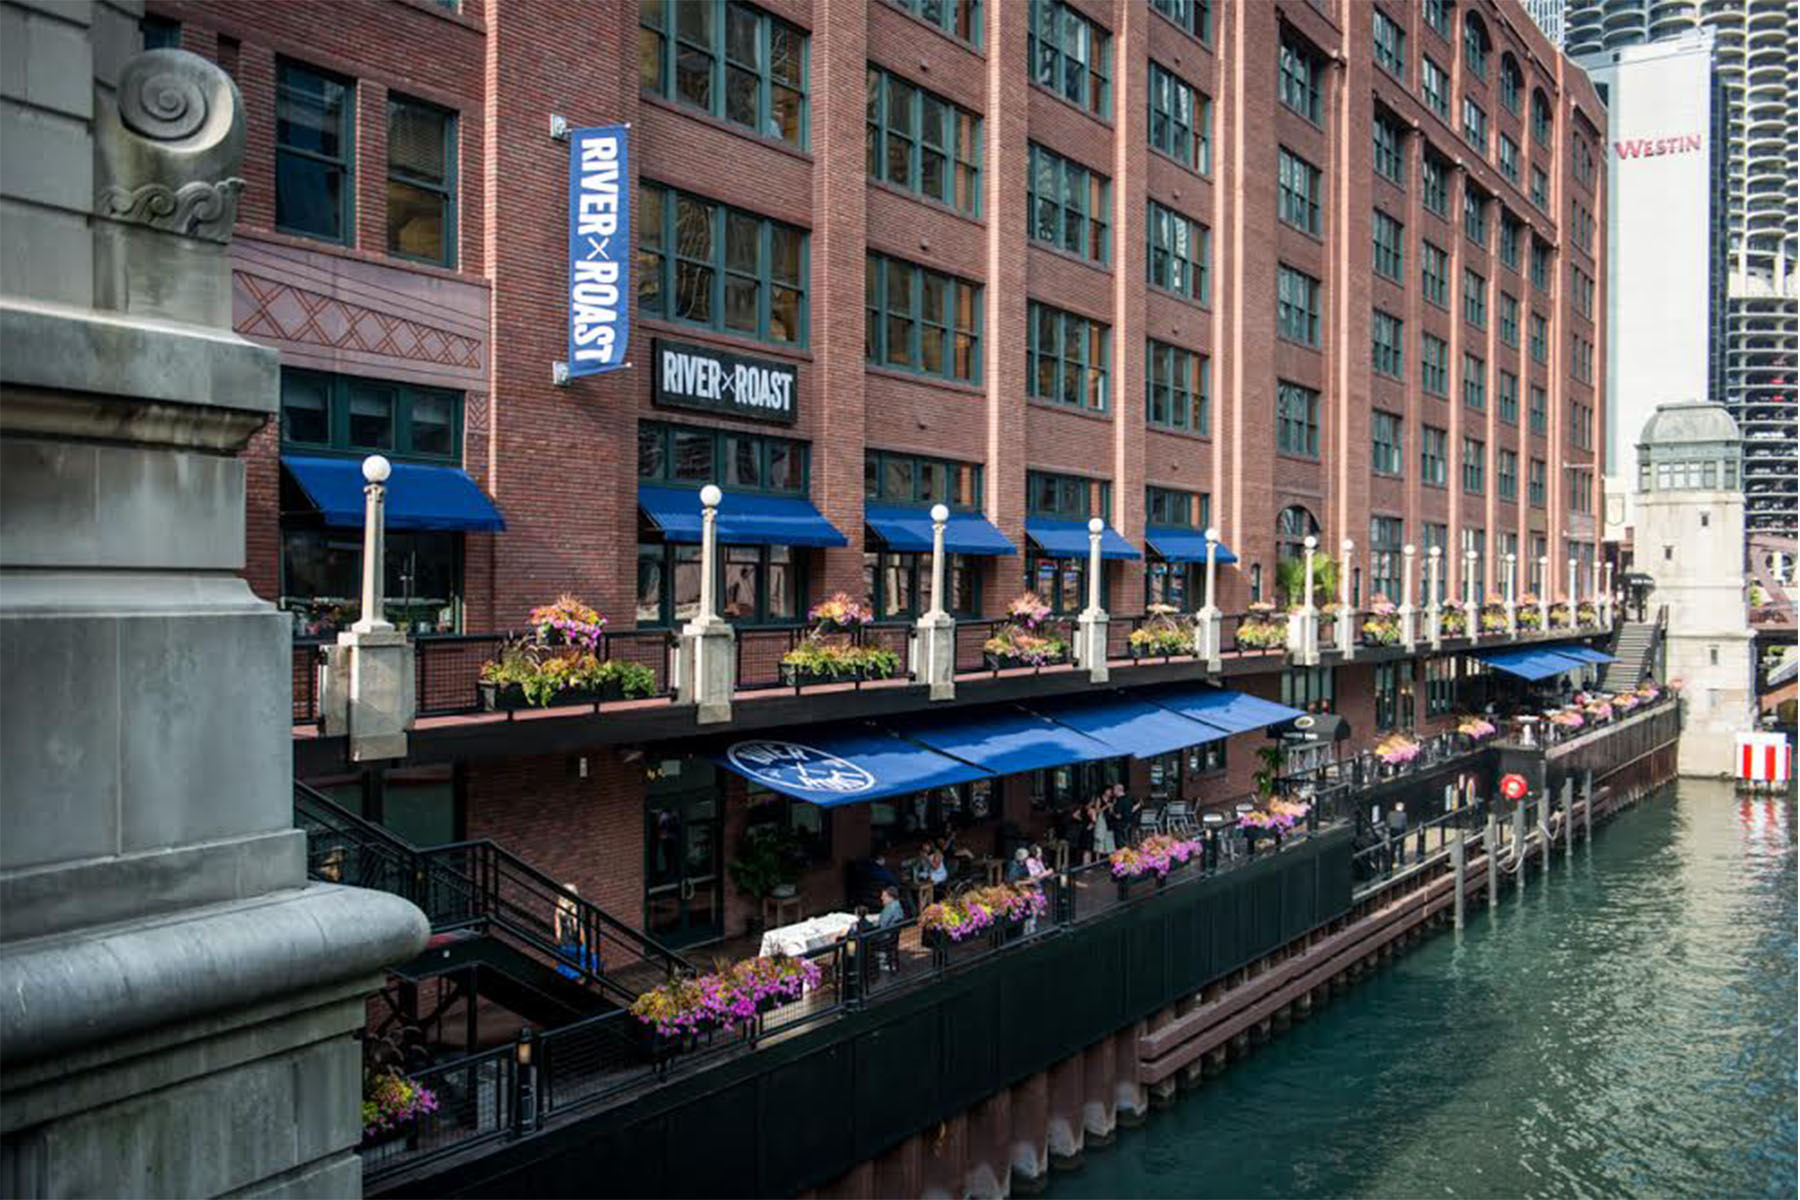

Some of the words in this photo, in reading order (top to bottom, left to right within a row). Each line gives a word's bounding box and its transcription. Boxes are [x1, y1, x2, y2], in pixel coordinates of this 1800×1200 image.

[579, 137, 618, 235] RIVER
[1614, 135, 1701, 160] WESTIN
[573, 261, 618, 363] ROAST
[663, 351, 721, 399] RIVER
[735, 364, 792, 410] ROAST
